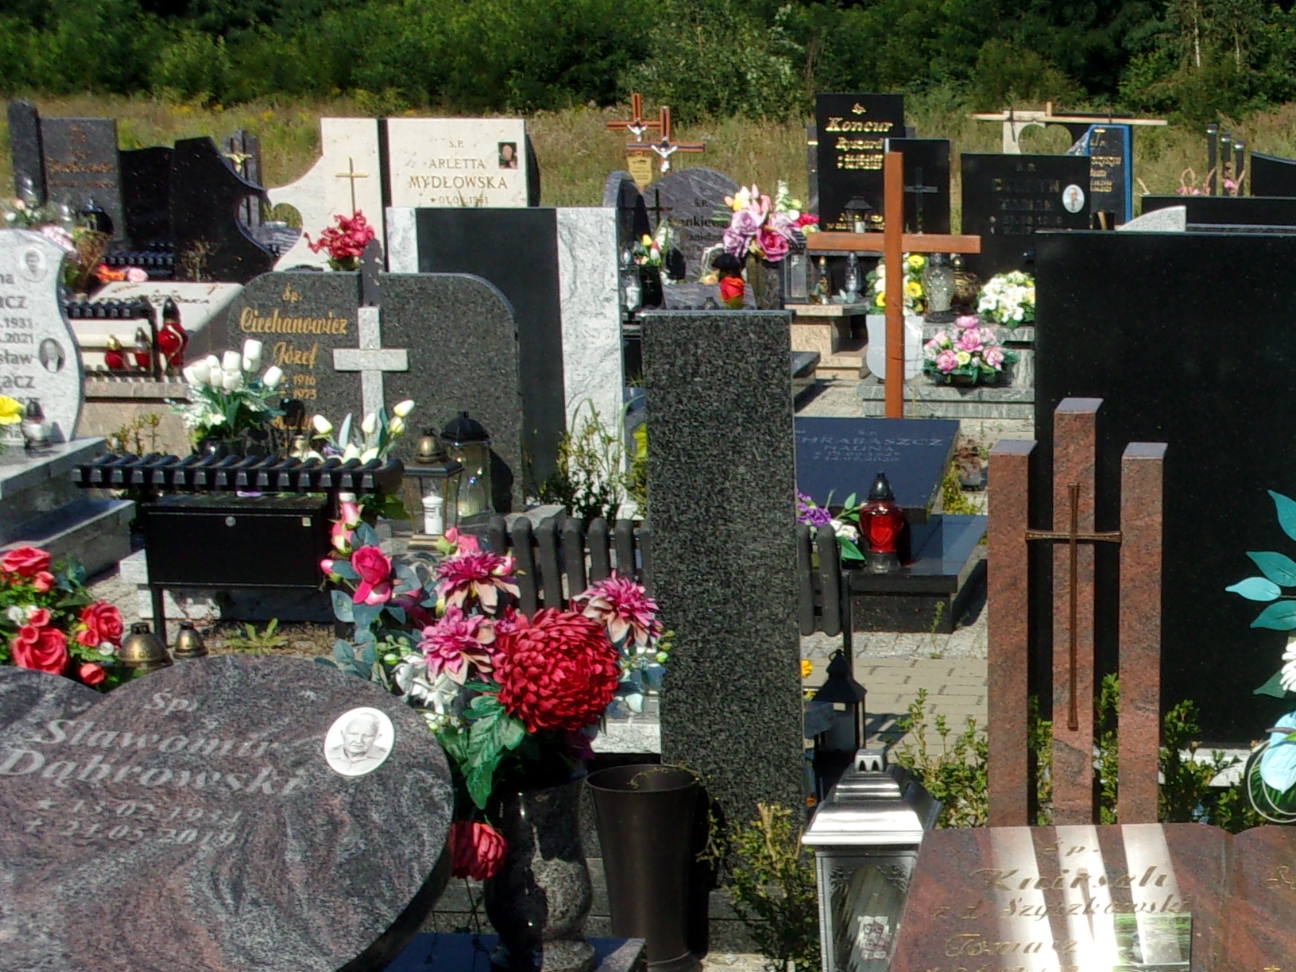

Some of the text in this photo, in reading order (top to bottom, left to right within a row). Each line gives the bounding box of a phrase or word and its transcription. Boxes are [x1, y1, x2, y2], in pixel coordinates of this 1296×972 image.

[825, 116, 894, 132] Koncur
[428, 158, 486, 170] ARLETTA
[408, 175, 508, 190] MYDŁOWSKA
[239, 307, 350, 336] Ciechanowicz
[272, 340, 320, 370] Józef
